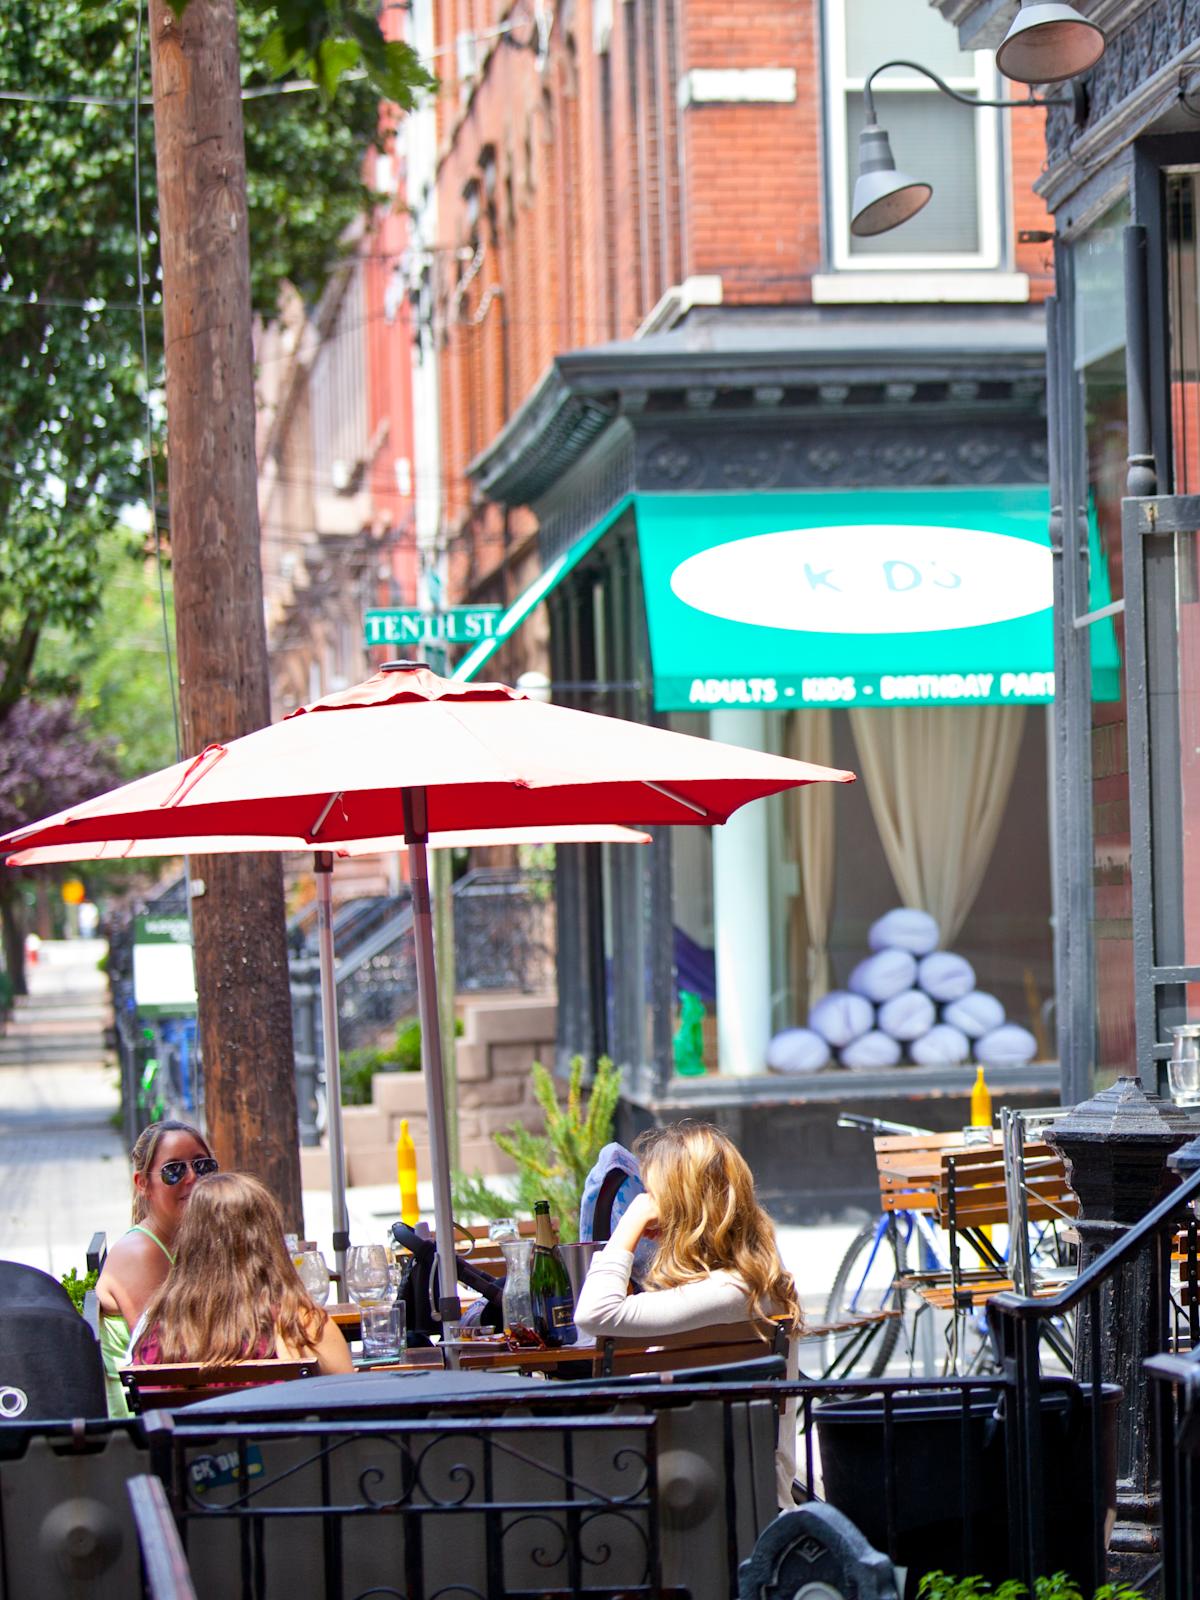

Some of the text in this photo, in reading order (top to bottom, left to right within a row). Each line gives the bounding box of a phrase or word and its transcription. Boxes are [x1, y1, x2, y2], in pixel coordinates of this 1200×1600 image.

[367, 614, 457, 641] TENTH
[689, 679, 778, 703] ADULTS
[802, 677, 857, 702] KIDS
[880, 674, 994, 700] BIRTHDAY
